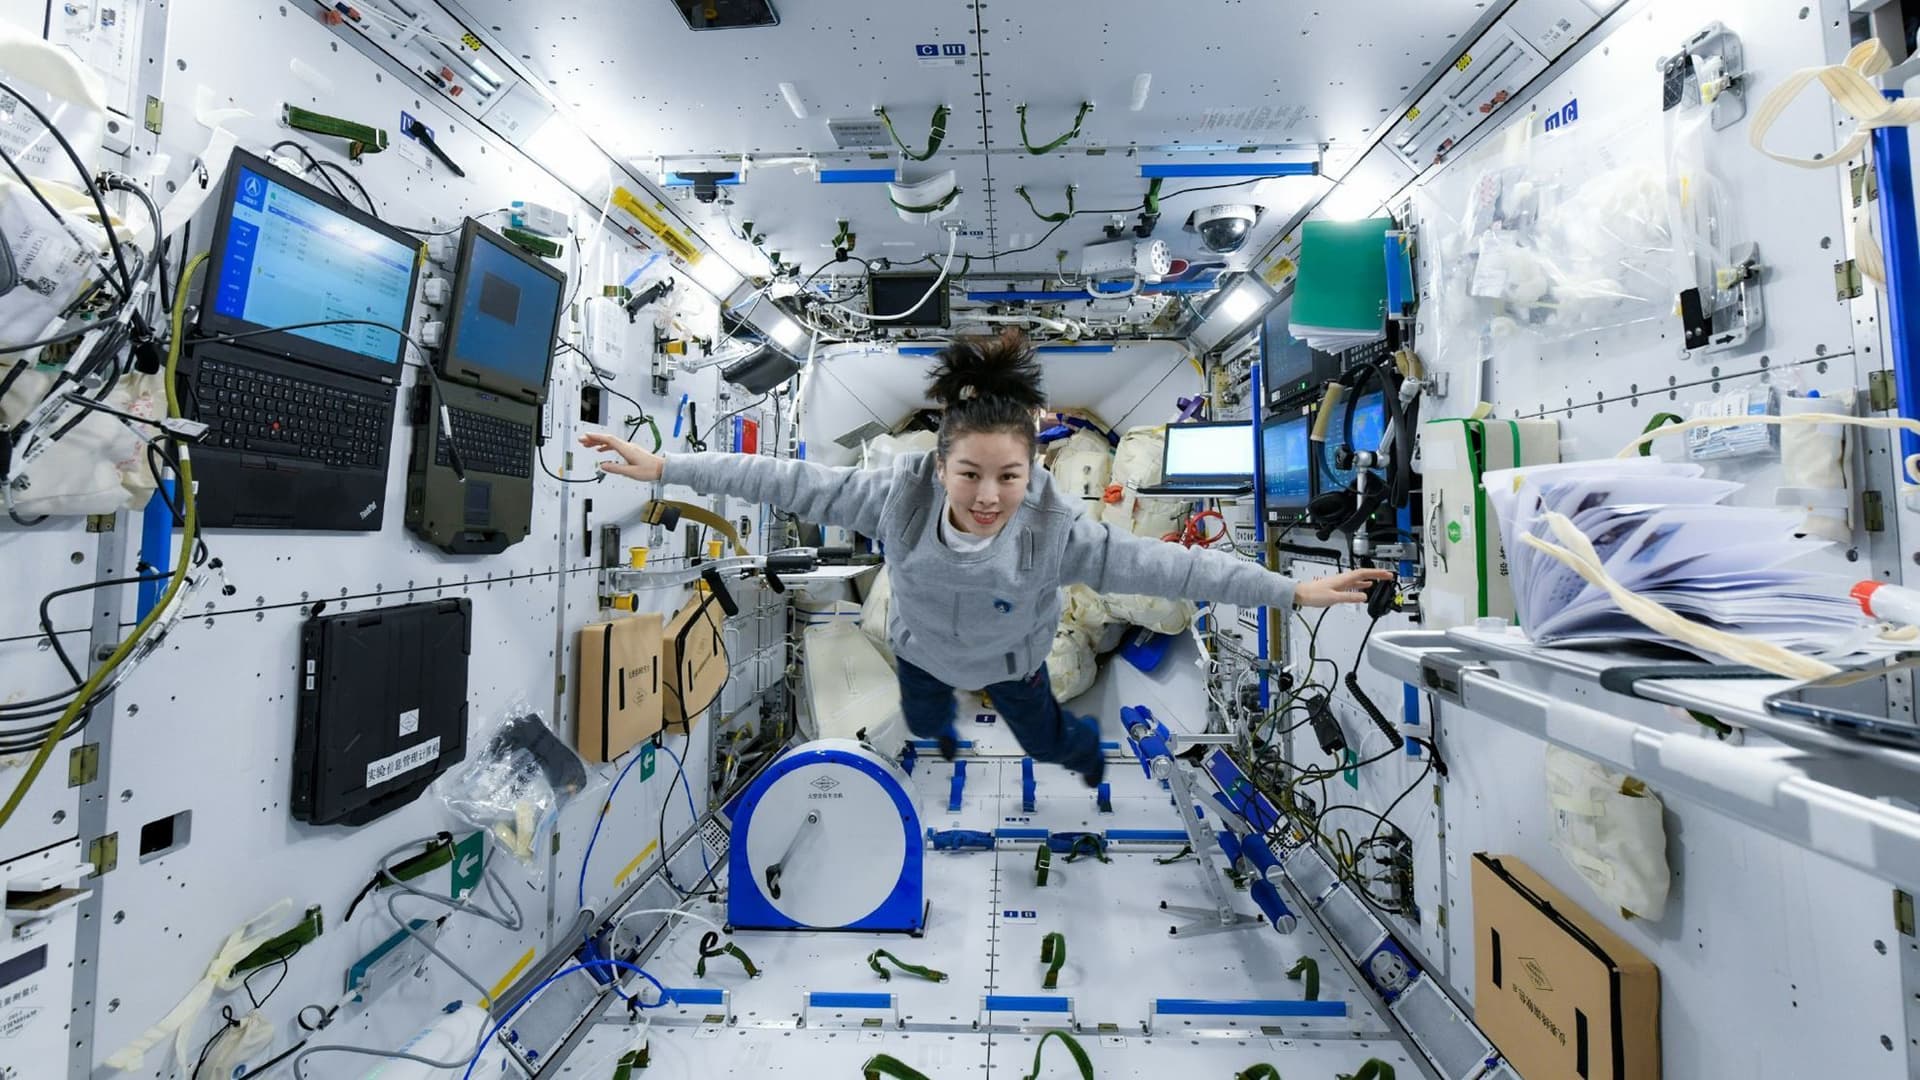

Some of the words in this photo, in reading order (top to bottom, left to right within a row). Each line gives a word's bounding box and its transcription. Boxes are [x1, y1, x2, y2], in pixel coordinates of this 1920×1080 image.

[922, 45, 933, 55] C
[945, 45, 963, 55] III
[359, 500, 377, 521] ThinkPad
[368, 742, 439, 782] 实验信息管理计算机
